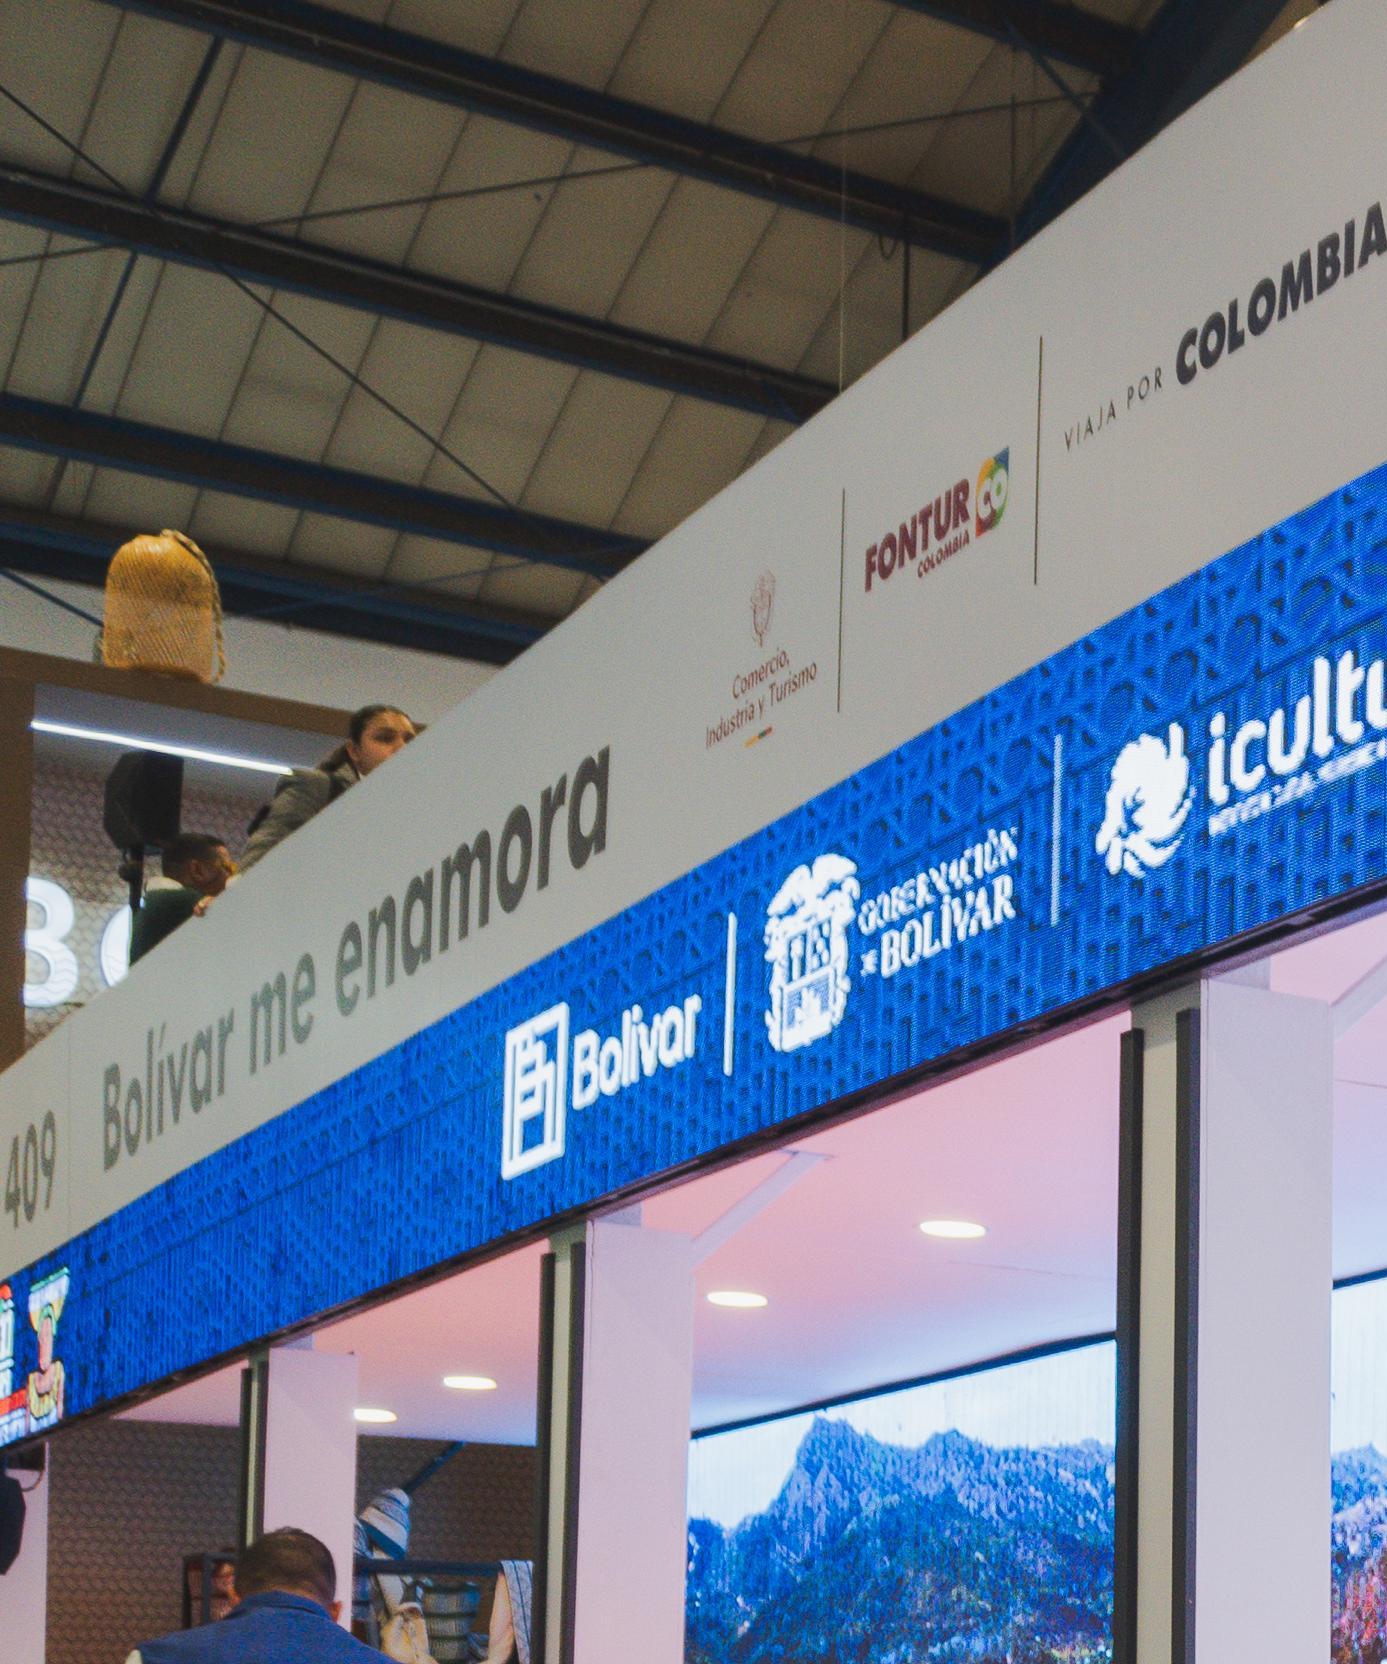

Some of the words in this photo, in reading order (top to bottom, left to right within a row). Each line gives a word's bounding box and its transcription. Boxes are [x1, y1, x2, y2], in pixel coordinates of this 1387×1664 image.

[1063, 400, 1117, 453] VIAJA
[1126, 366, 1163, 411] POR
[864, 478, 971, 593] FONTUR
[917, 529, 970, 579] COLOMBIA
[705, 699, 755, 750] Industria
[757, 694, 765, 720] y
[767, 661, 818, 706] Turismo
[731, 648, 790, 700] Comercio,
[103, 1007, 235, 1173] Bolívar
[249, 951, 317, 1077] me
[335, 744, 611, 1017] enamora
[880, 873, 1017, 979] BOLÍVAR
[5, 1109, 56, 1229] 409
